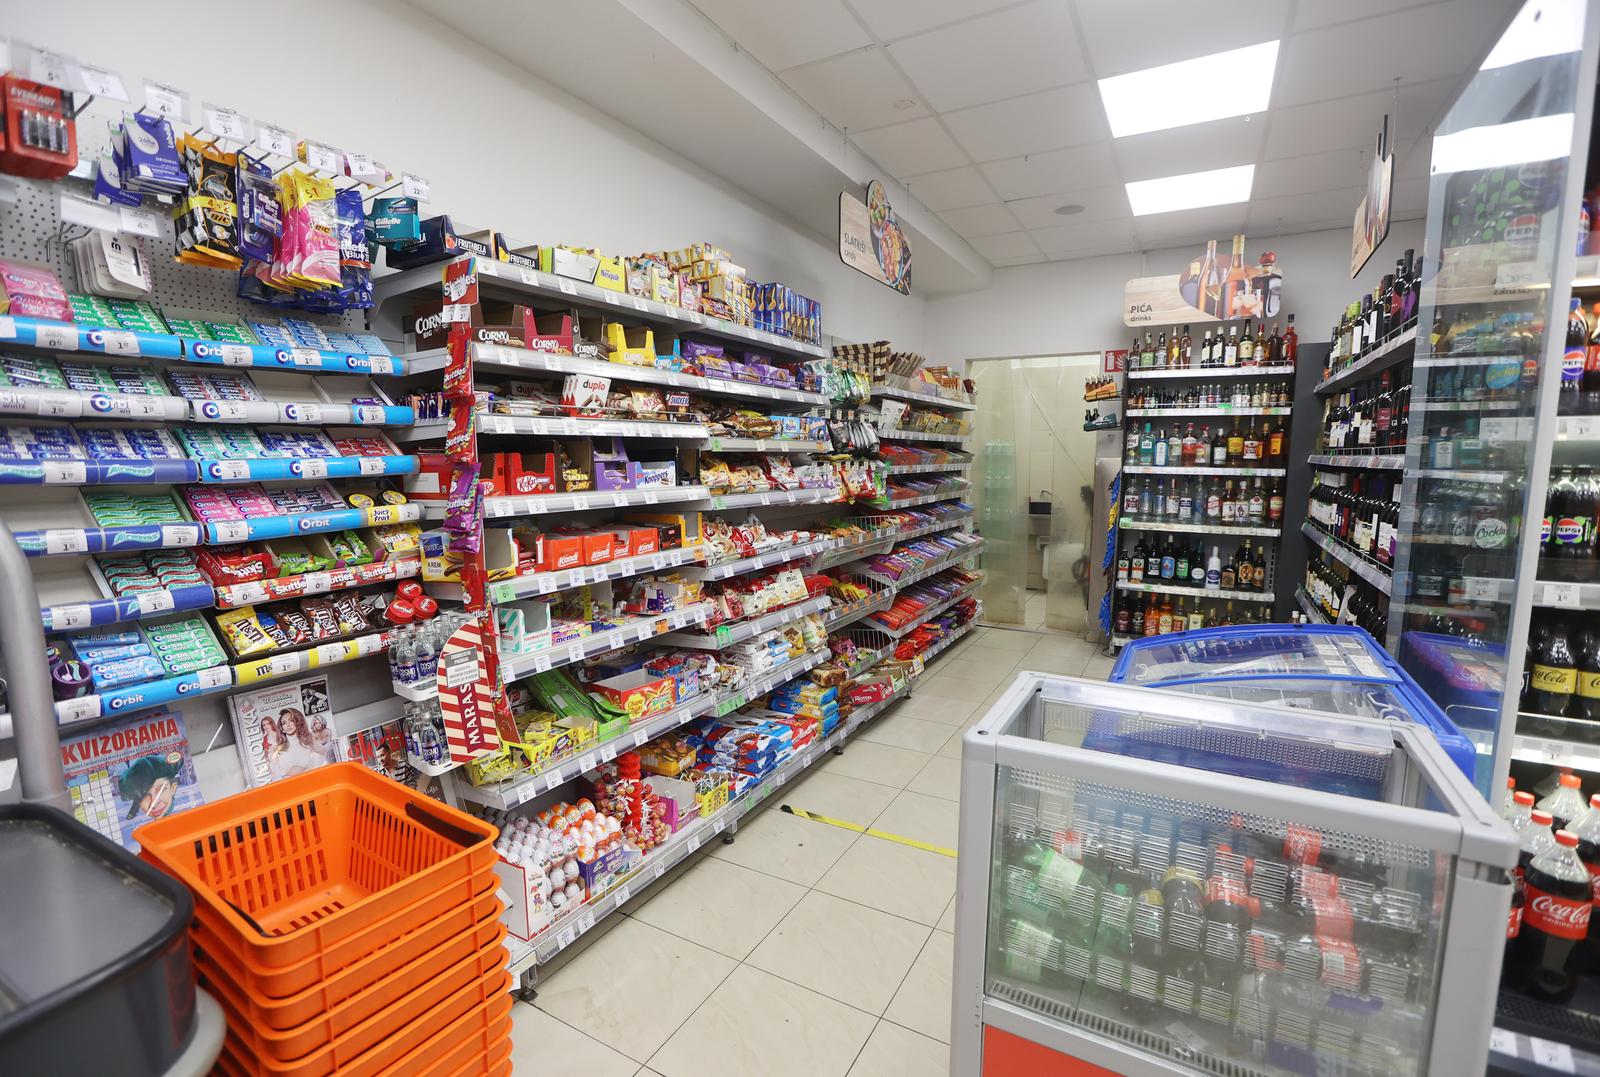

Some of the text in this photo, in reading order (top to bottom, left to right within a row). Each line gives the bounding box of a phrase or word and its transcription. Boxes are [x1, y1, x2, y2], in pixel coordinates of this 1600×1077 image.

[210, 213, 230, 225] BIC
[375, 218, 401, 226] Gillette
[315, 224, 330, 235] BIC
[457, 238, 487, 255] FRUTABELA
[509, 253, 536, 269] FRUTABELA
[844, 249, 856, 262] candy
[600, 268, 621, 281] Nesquik
[1130, 302, 1152, 314] PIĆA
[478, 329, 510, 343] CORNY
[532, 338, 559, 351] CORNY
[574, 343, 598, 355] CORNY
[582, 380, 606, 392] duplo
[107, 464, 154, 478] Airwaves
[517, 476, 537, 492] KitKat
[644, 471, 669, 485] Knoppers
[372, 509, 390, 520] Juicy
[373, 514, 390, 522] Fruit
[298, 518, 331, 530] Orbit
[113, 530, 161, 546] Airwaves
[362, 566, 392, 580] Skittles
[148, 624, 171, 632] Orbit
[154, 634, 179, 642] Orbit
[555, 632, 581, 644] mentos
[88, 647, 114, 658] Orbit
[159, 643, 184, 651] Orbit
[164, 652, 189, 661] Orbit
[96, 663, 125, 673] Orbit
[170, 662, 195, 672] Orbit
[103, 670, 130, 679] Orbit
[110, 694, 144, 709] Orbit
[62, 718, 178, 766] KVIZORAMA
[1543, 916, 1571, 928] ORIGINAL
